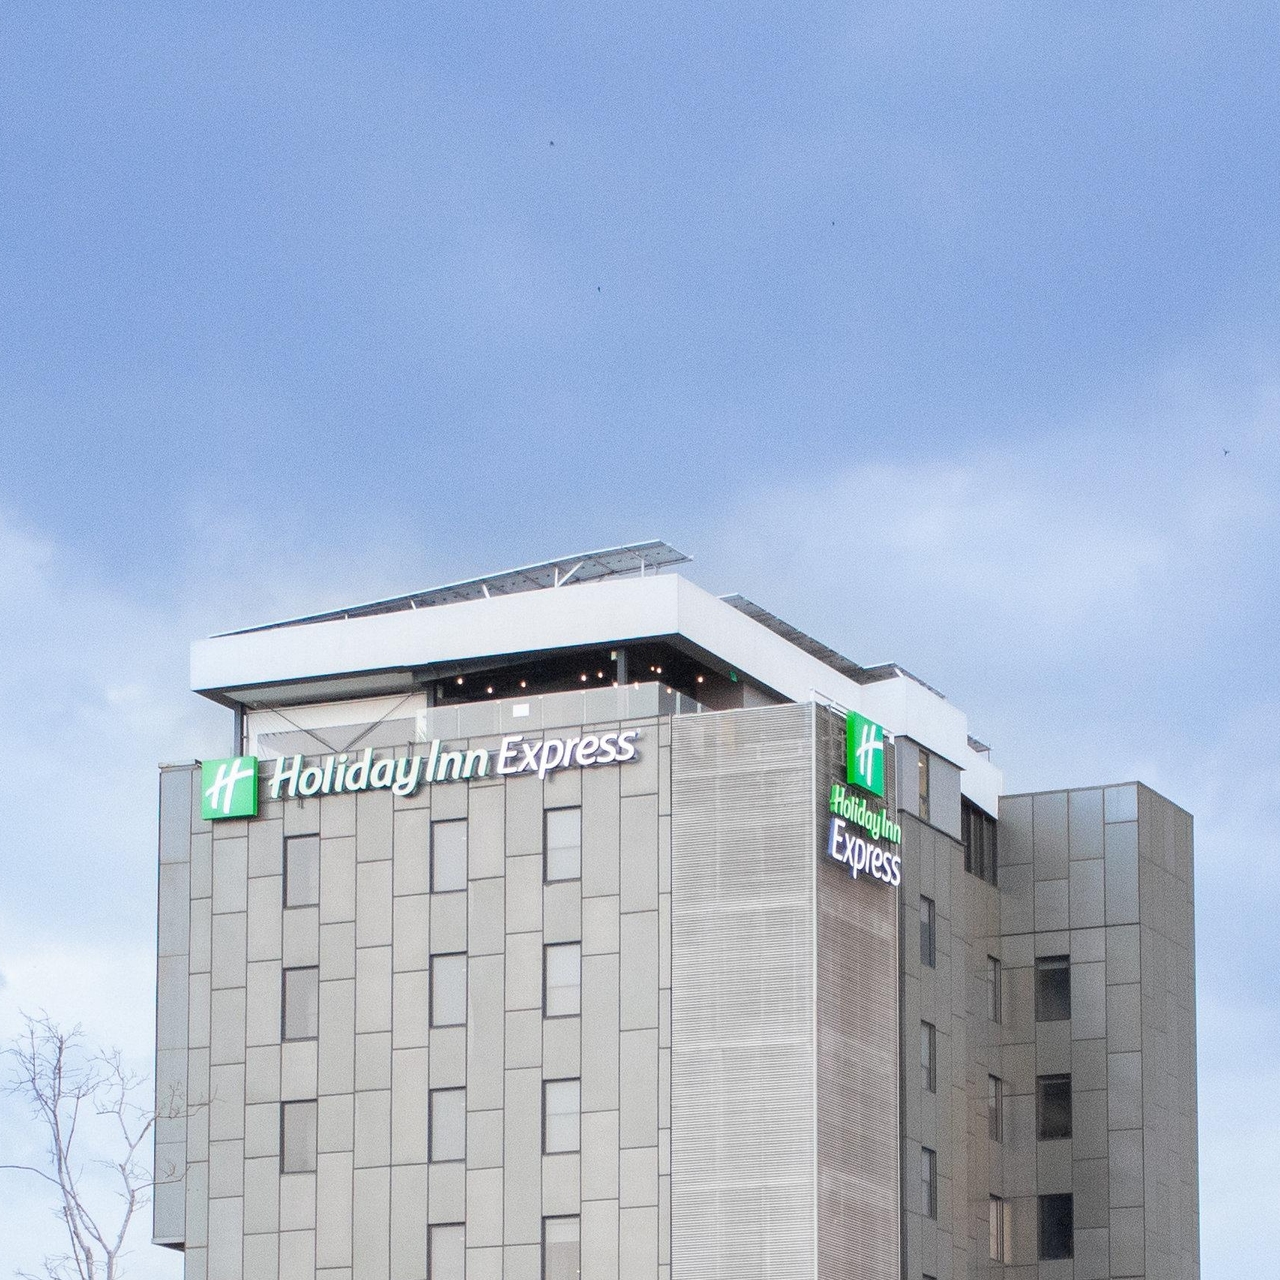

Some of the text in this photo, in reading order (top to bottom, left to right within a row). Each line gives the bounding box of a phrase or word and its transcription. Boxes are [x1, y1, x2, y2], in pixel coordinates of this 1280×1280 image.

[270, 732, 636, 798] Holiday Inn Express
[831, 785, 901, 844] Holiday Inn
[830, 817, 901, 887] Express
